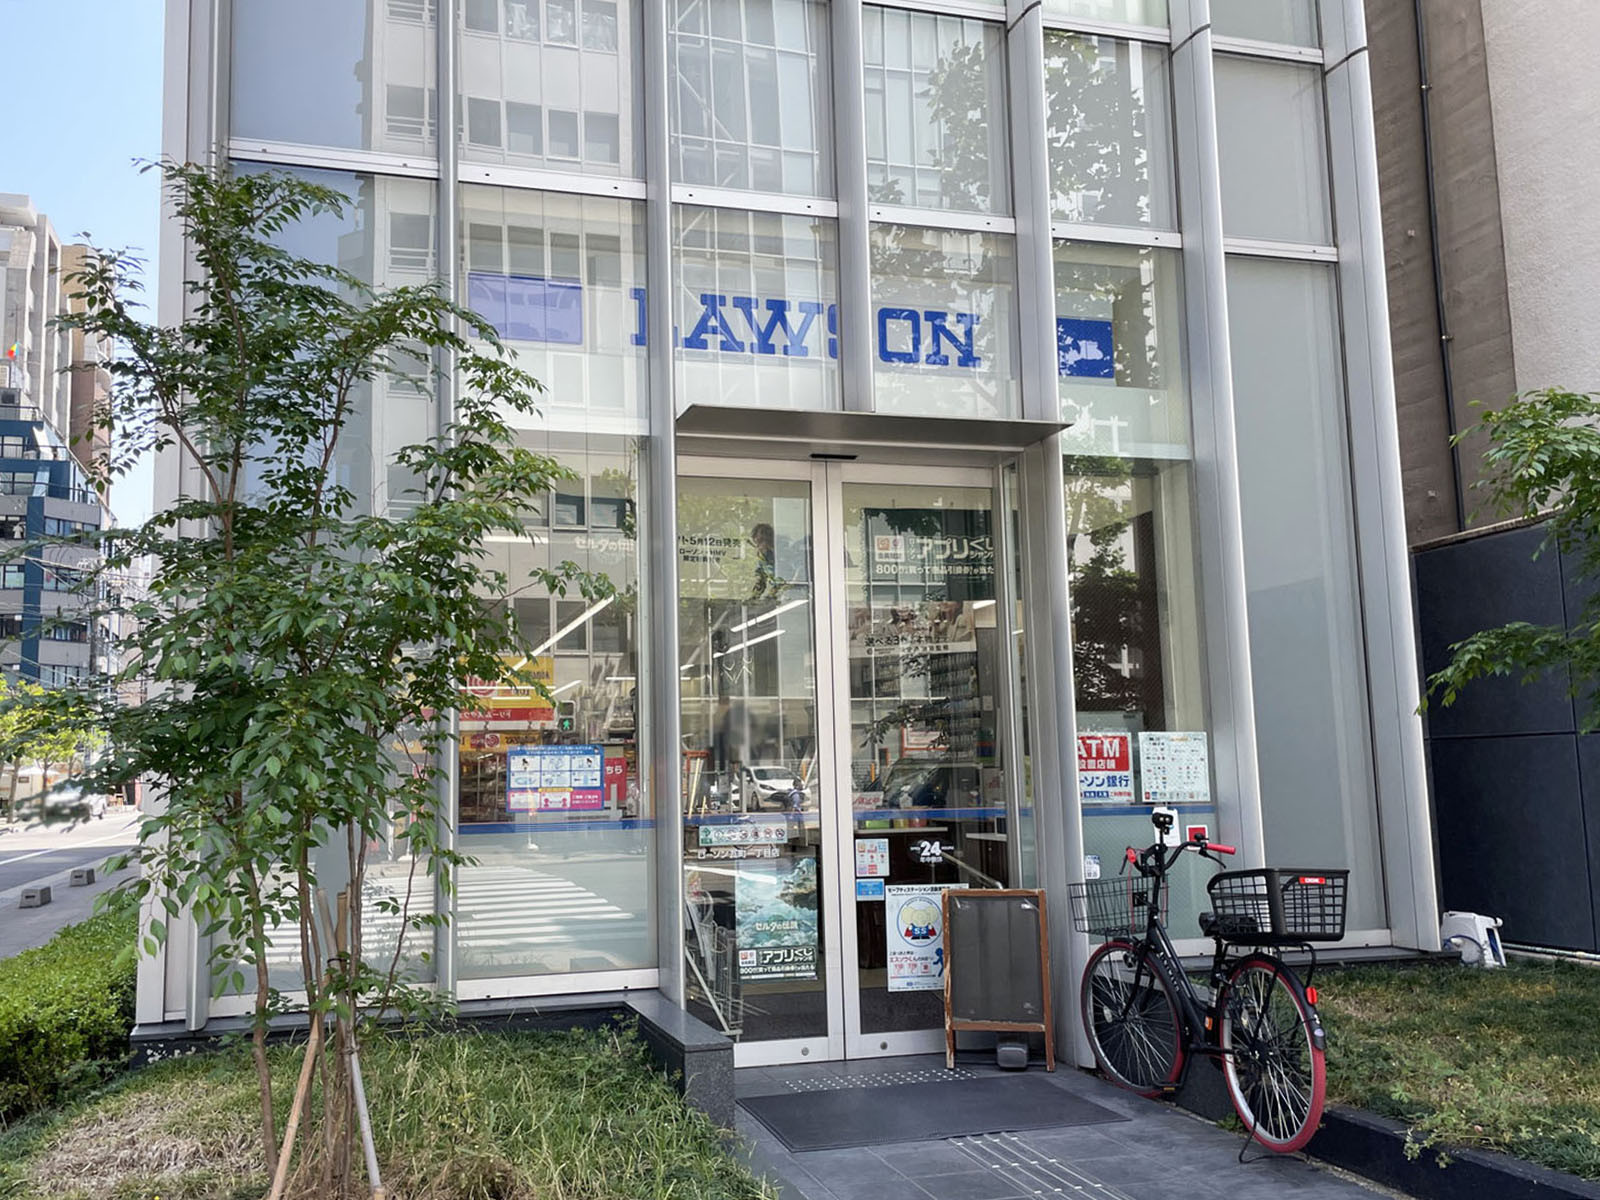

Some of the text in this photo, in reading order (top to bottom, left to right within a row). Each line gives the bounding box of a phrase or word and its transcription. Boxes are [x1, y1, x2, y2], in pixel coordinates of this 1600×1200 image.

[630, 288, 981, 367] LAWON
[1078, 739, 1120, 758] ATM
[920, 840, 942, 856] 24
